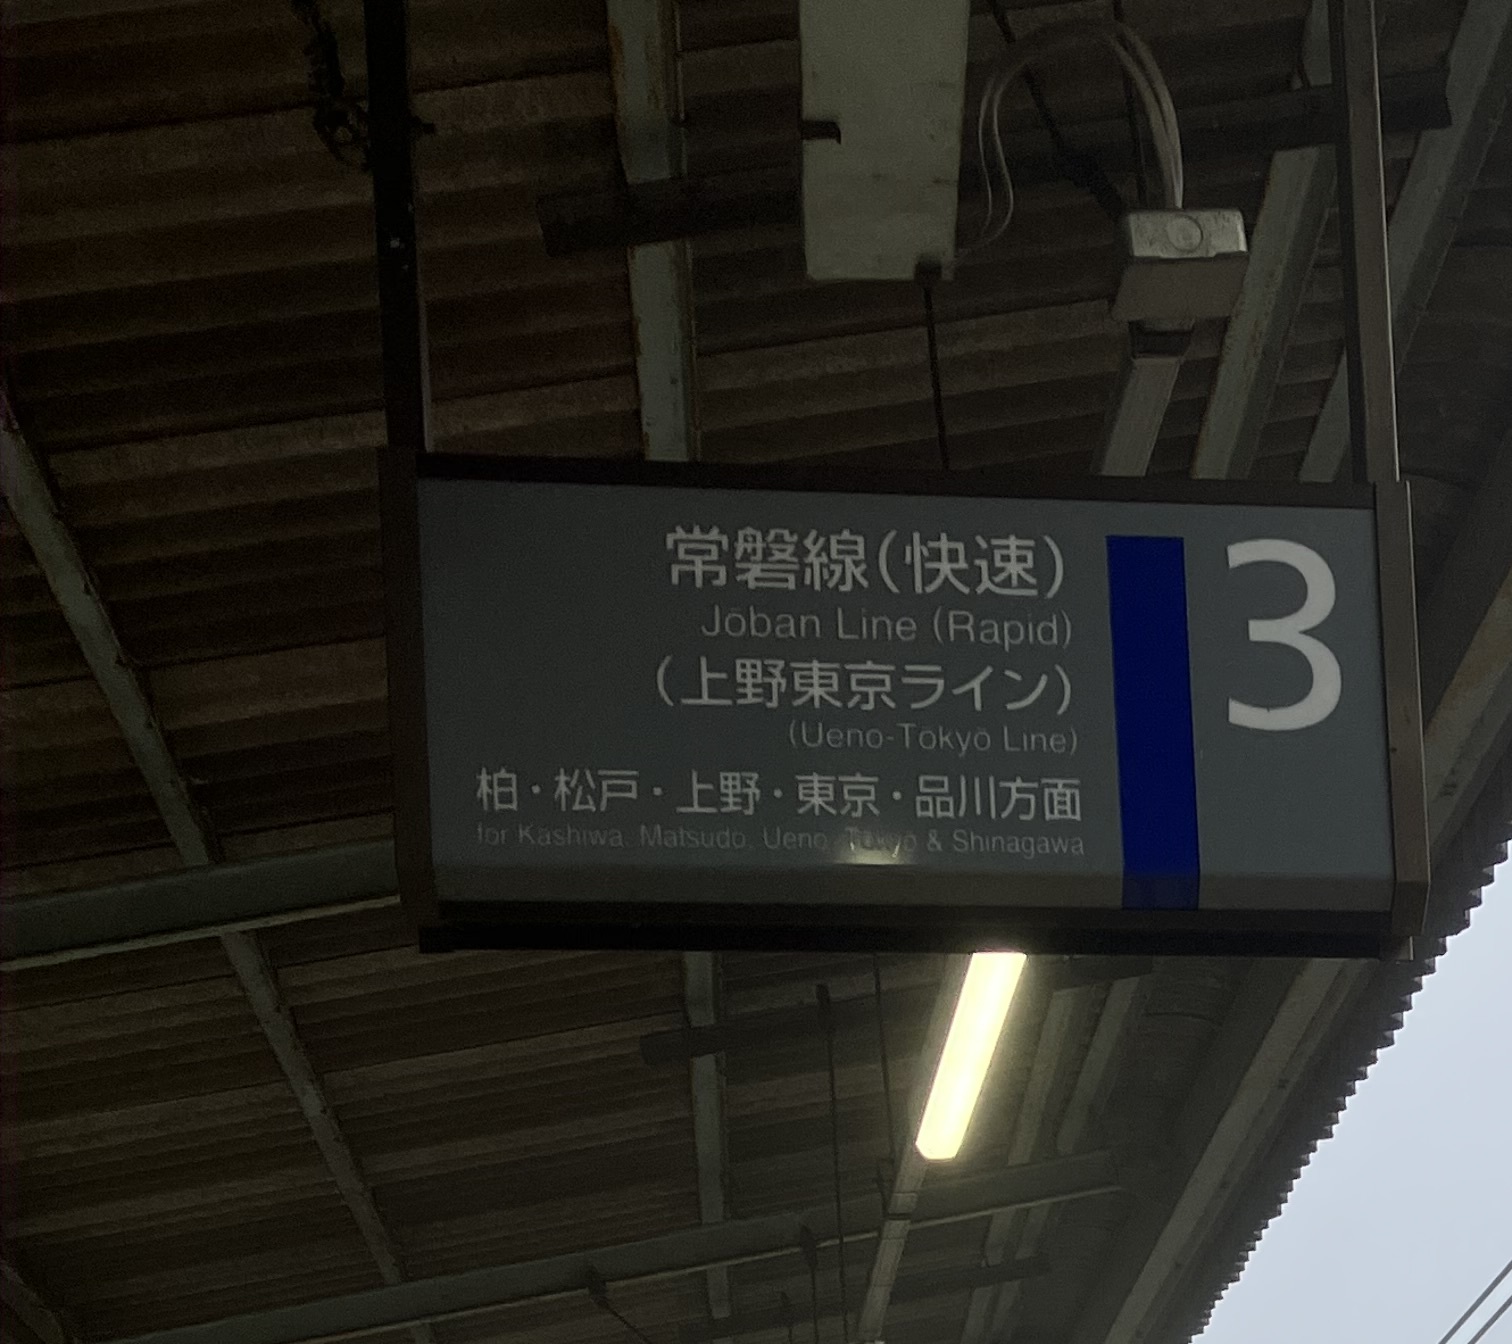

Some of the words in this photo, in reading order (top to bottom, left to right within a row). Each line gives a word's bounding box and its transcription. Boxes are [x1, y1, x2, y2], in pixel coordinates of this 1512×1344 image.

[665, 525, 1064, 599] 常磐線(快速)
[837, 607, 917, 641] Line
[932, 606, 1072, 652] (Rapid)
[1226, 538, 1344, 732] 3
[656, 655, 1073, 717] (上野東京ライン)
[1003, 724, 1078, 757] Line)
[475, 767, 1083, 822] 柏・松戸・上野・東京・品川方面
[476, 824, 508, 846] for
[927, 830, 942, 851] &
[952, 828, 1085, 859] Shinagawa
